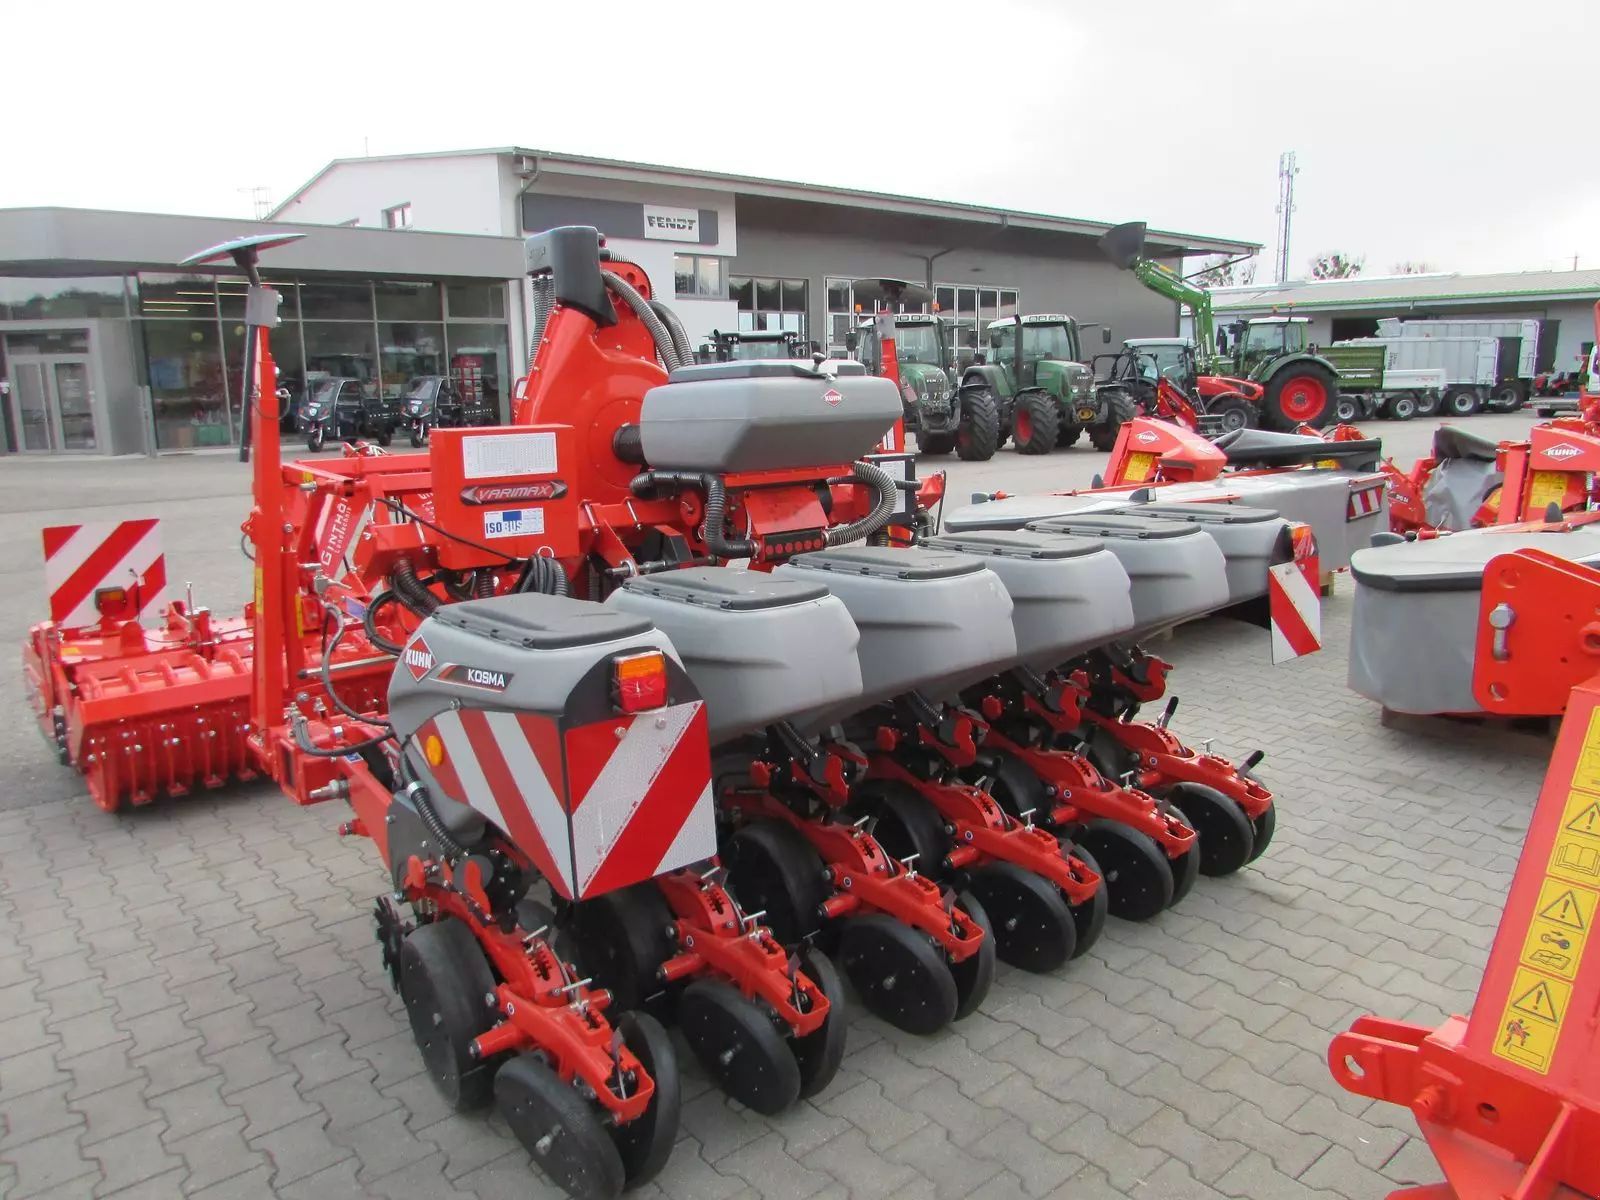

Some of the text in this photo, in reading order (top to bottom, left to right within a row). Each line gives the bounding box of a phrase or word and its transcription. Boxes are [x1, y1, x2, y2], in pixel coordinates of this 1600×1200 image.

[647, 215, 696, 230] FENDT
[1547, 448, 1578, 456] KUHN
[479, 485, 552, 500] VARIMAX
[405, 649, 432, 670] KUHN
[467, 668, 506, 688] KOSMA
